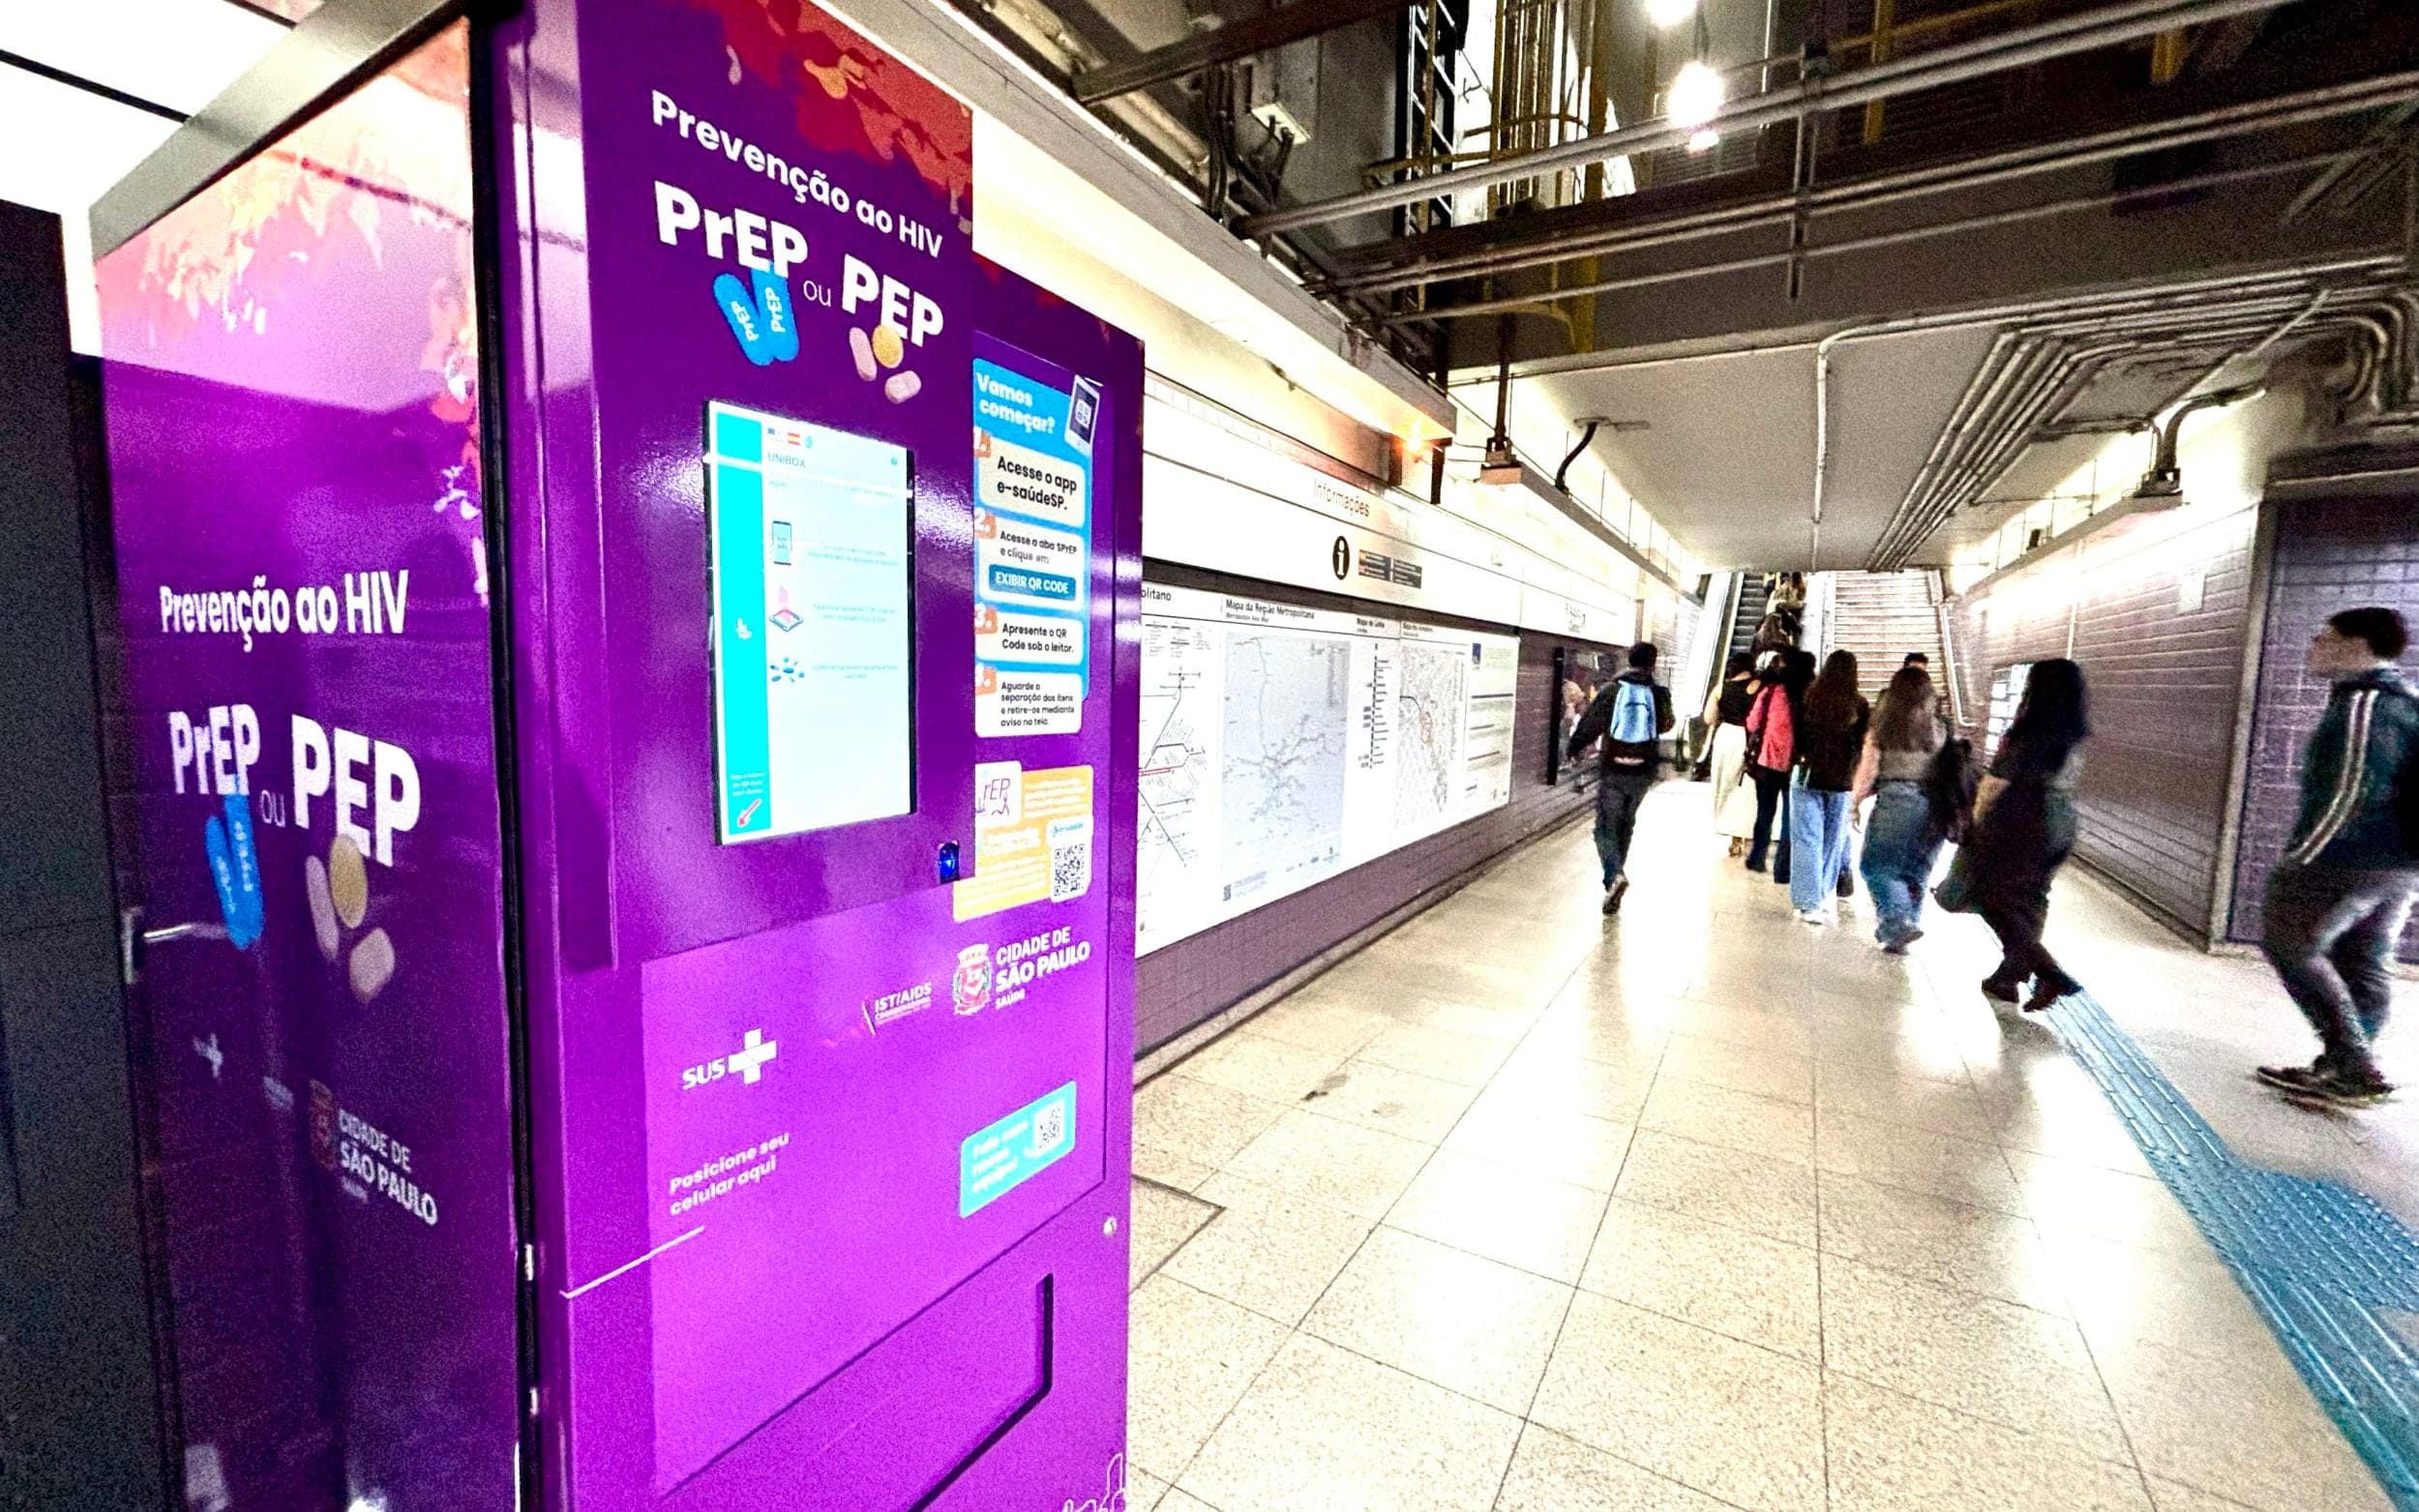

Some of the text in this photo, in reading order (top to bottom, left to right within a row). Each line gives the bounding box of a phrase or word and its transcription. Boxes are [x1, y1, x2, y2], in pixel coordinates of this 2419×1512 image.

[652, 89, 943, 259] Prevenção ao HIV
[654, 180, 809, 279] PrEP
[803, 280, 831, 309] ou
[842, 253, 944, 347] PEP
[975, 371, 1033, 408] Vamos
[979, 399, 1056, 434] começar?
[998, 455, 1077, 496] Acesse o app
[997, 480, 1068, 511] e-saúdeSP.
[1000, 530, 1030, 546] Acesse
[1039, 539, 1055, 551] aba
[1000, 547, 1006, 557] e
[1007, 547, 1033, 563] clique
[995, 570, 1069, 594] EXIBIR QR CODE
[159, 568, 409, 653] Prevenção ao HIV
[1225, 598, 1244, 611] Mapa
[1245, 602, 1253, 612] da
[1001, 638, 1026, 650] Code
[1028, 640, 1042, 652] sob
[1044, 643, 1050, 652] o
[1002, 622, 1067, 638] Apresente o QR
[1000, 681, 1034, 693] Aguarde
[1000, 693, 1042, 704] separação
[1000, 717, 1022, 726] aviso
[168, 703, 261, 796] PrEP
[259, 789, 286, 828] ou
[291, 714, 422, 868] PEP
[995, 926, 1072, 965] CIDADE DE
[995, 940, 1091, 994] SÃO PAULO
[874, 982, 933, 1012] IST/AIDS
[682, 1056, 726, 1090] SUS
[391, 1140, 412, 1173] DE
[670, 1132, 790, 1196] Posicione seu
[341, 1141, 375, 1183] SÃO
[377, 1162, 437, 1226] PAULO
[670, 1154, 777, 1216] celular aqui
